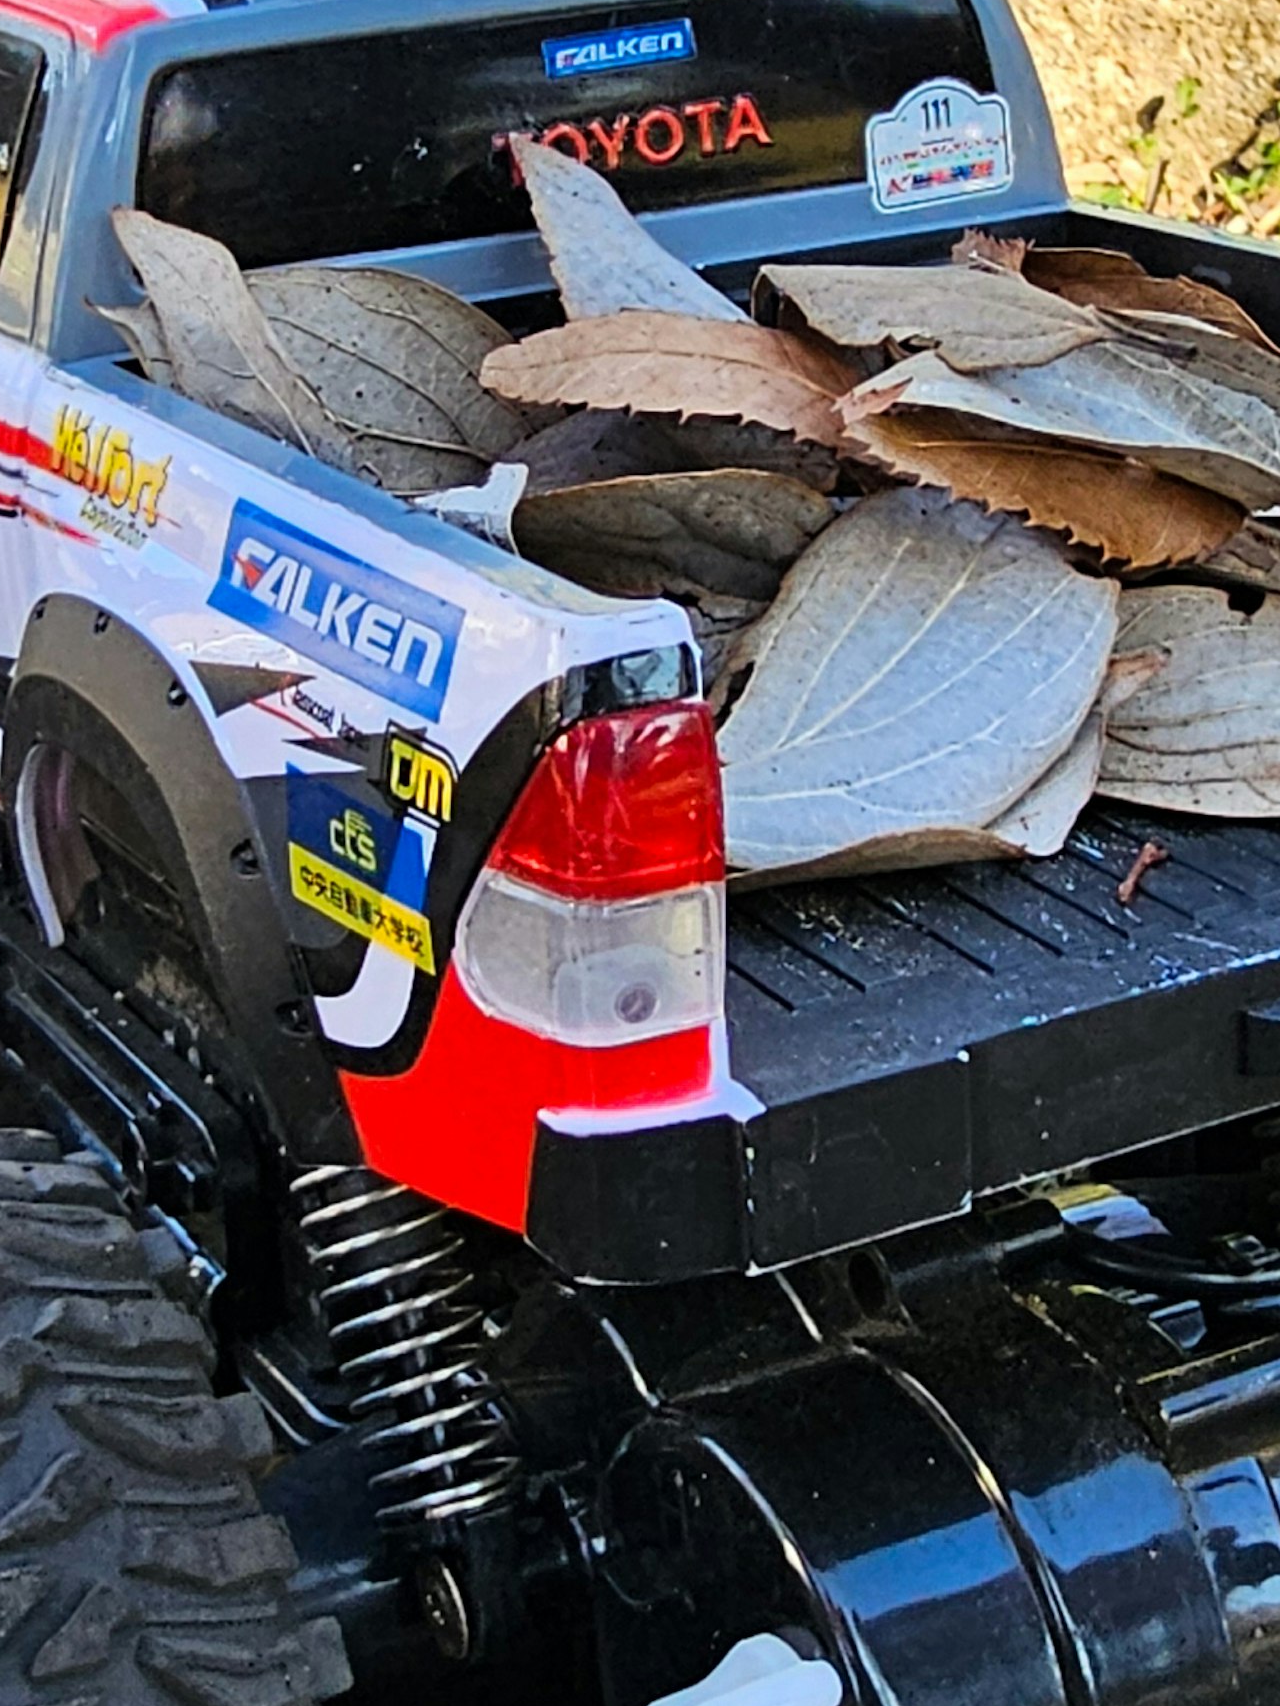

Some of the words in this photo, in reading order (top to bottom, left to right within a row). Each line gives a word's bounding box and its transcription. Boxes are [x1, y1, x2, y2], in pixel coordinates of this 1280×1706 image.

[555, 30, 683, 69] FALKEN
[921, 97, 952, 132] 111
[230, 536, 444, 688] FALKEN
